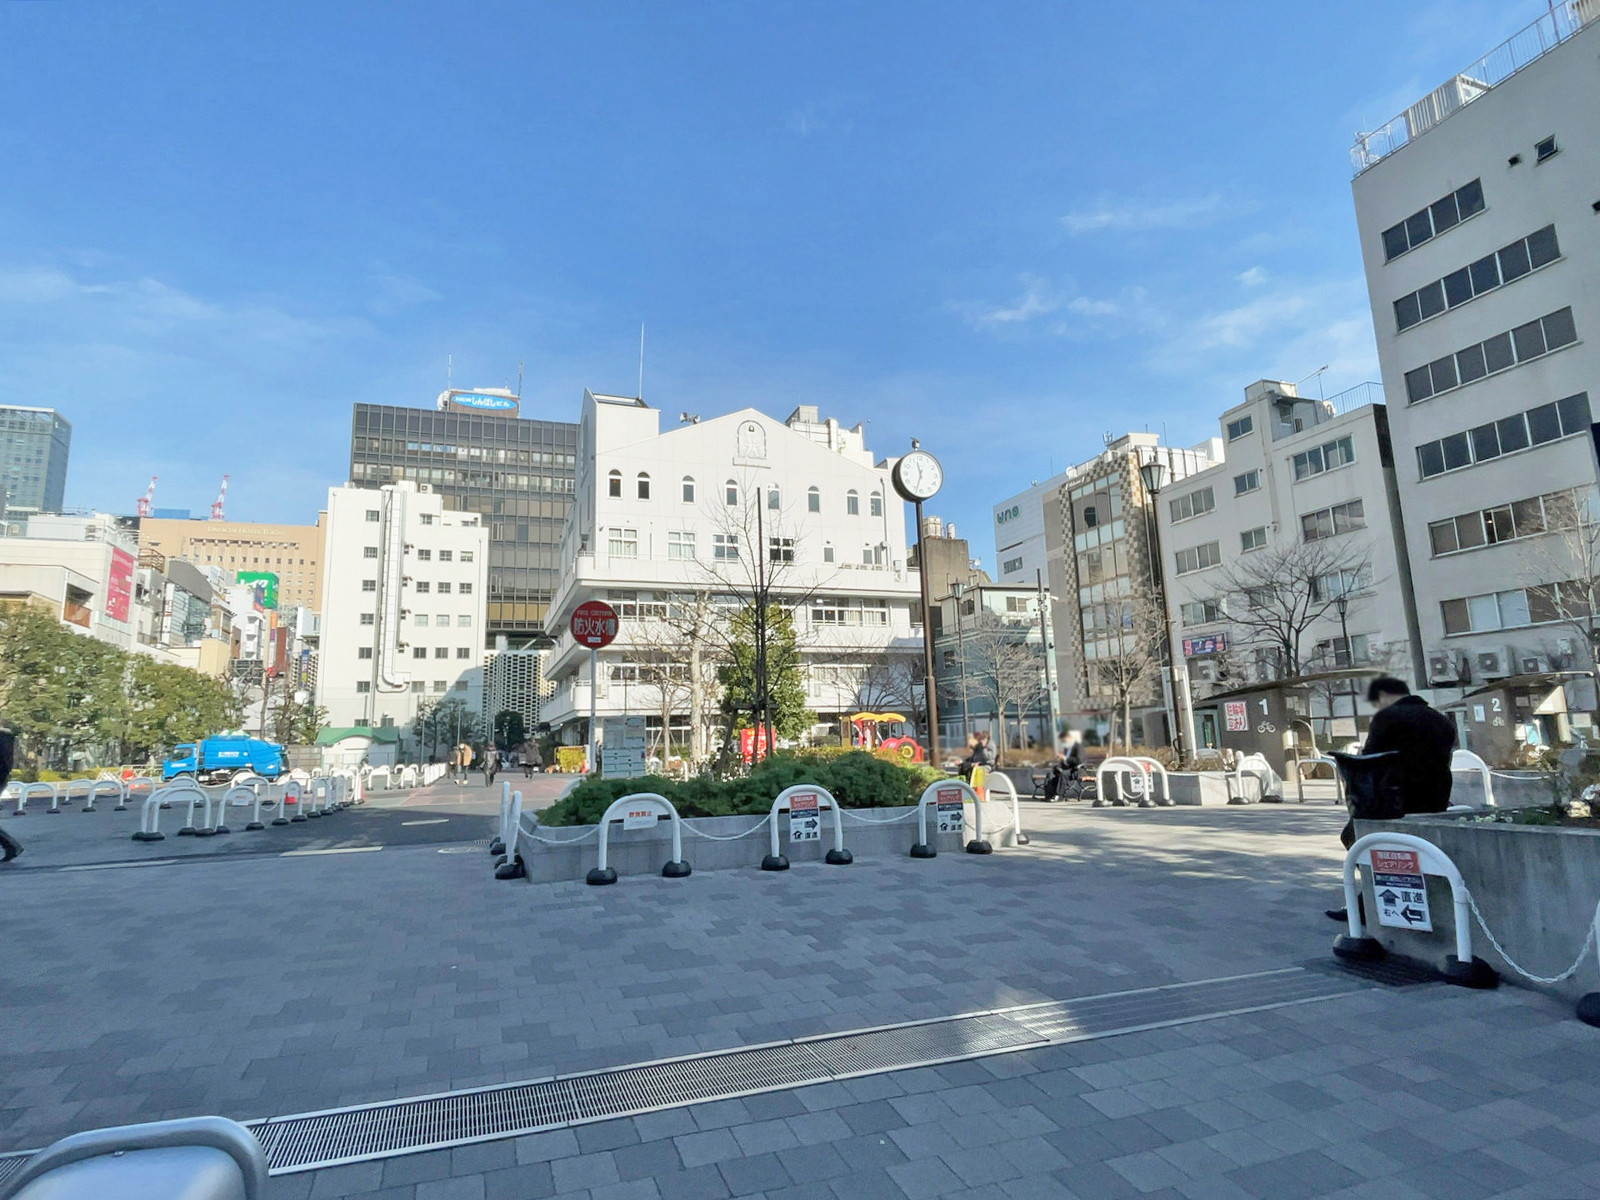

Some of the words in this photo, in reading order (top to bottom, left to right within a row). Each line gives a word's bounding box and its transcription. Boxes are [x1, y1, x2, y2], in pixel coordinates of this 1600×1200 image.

[573, 617, 616, 636] 防火水槽
[1258, 698, 1269, 716] 1
[1491, 698, 1502, 712] 2
[1401, 891, 1425, 904] 直進
[1384, 908, 1400, 917] 右へ
